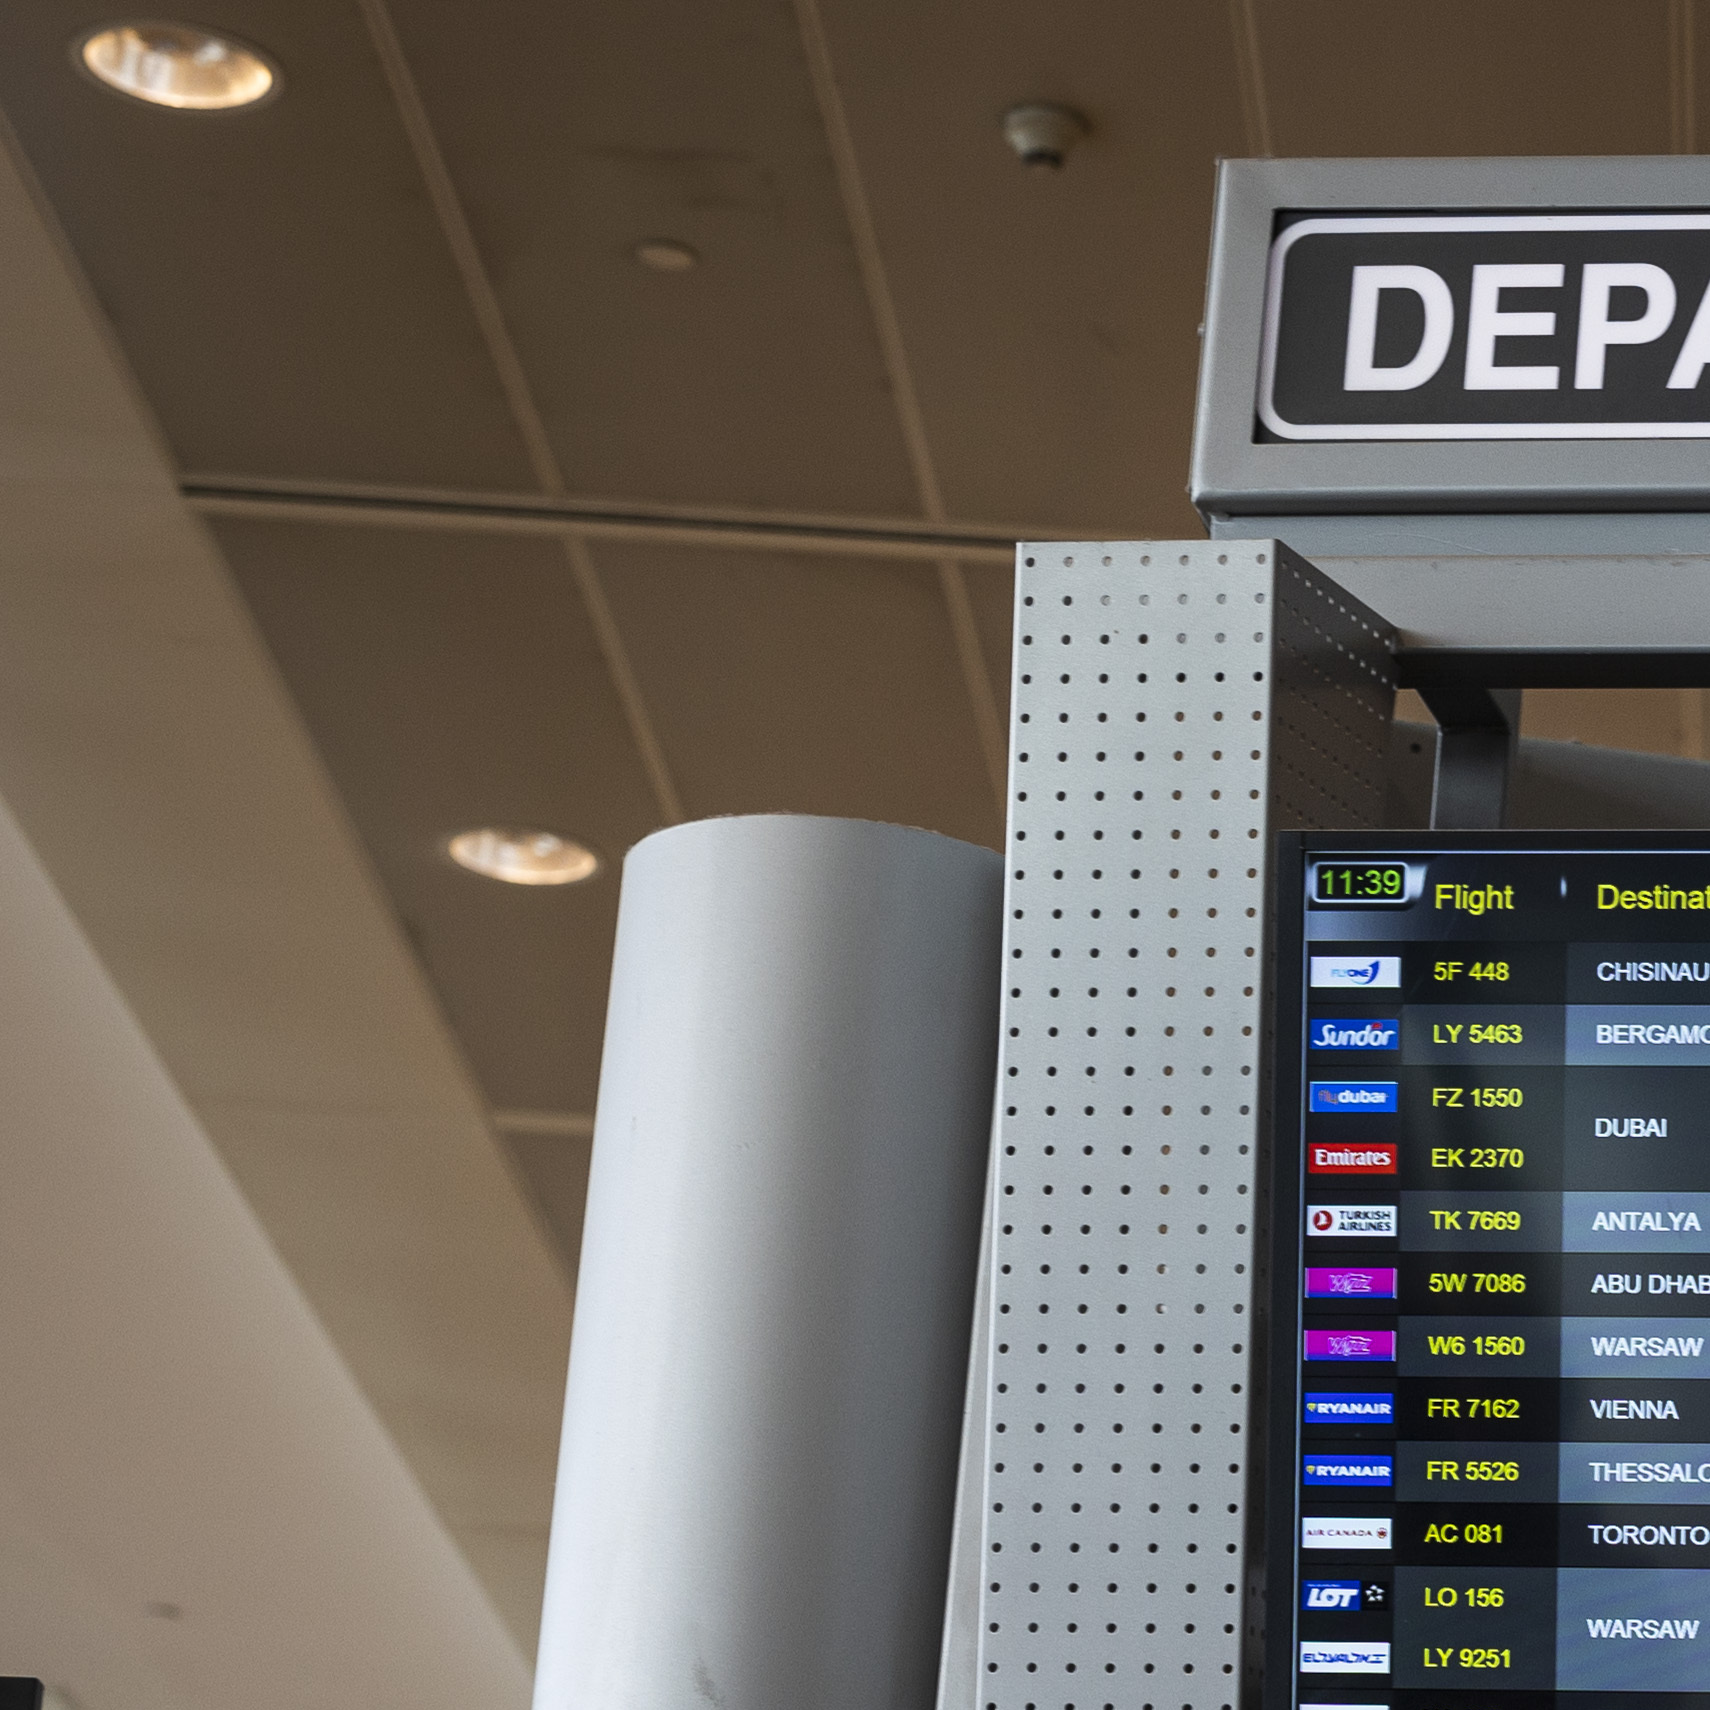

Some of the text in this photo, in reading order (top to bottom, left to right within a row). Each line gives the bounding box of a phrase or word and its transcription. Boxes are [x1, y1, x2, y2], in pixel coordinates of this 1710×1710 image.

[1320, 868, 1401, 895] 11:39
[1434, 883, 1515, 916] Flight
[1433, 961, 1511, 982] 5F 448
[1596, 961, 1710, 982] CHISINAU
[1432, 1023, 1524, 1044] LY 5463
[1314, 1148, 1391, 1166] Emirates
[1338, 1210, 1391, 1220] TURKISH
[1428, 1210, 1522, 1231] TK 7669
[1591, 1211, 1703, 1232] ANTALYA
[1337, 1221, 1391, 1231] AIRLINES
[1317, 1403, 1392, 1415] RYANAIR
[1426, 1460, 1520, 1482] FR 5526
[1307, 1588, 1359, 1607] LOT
